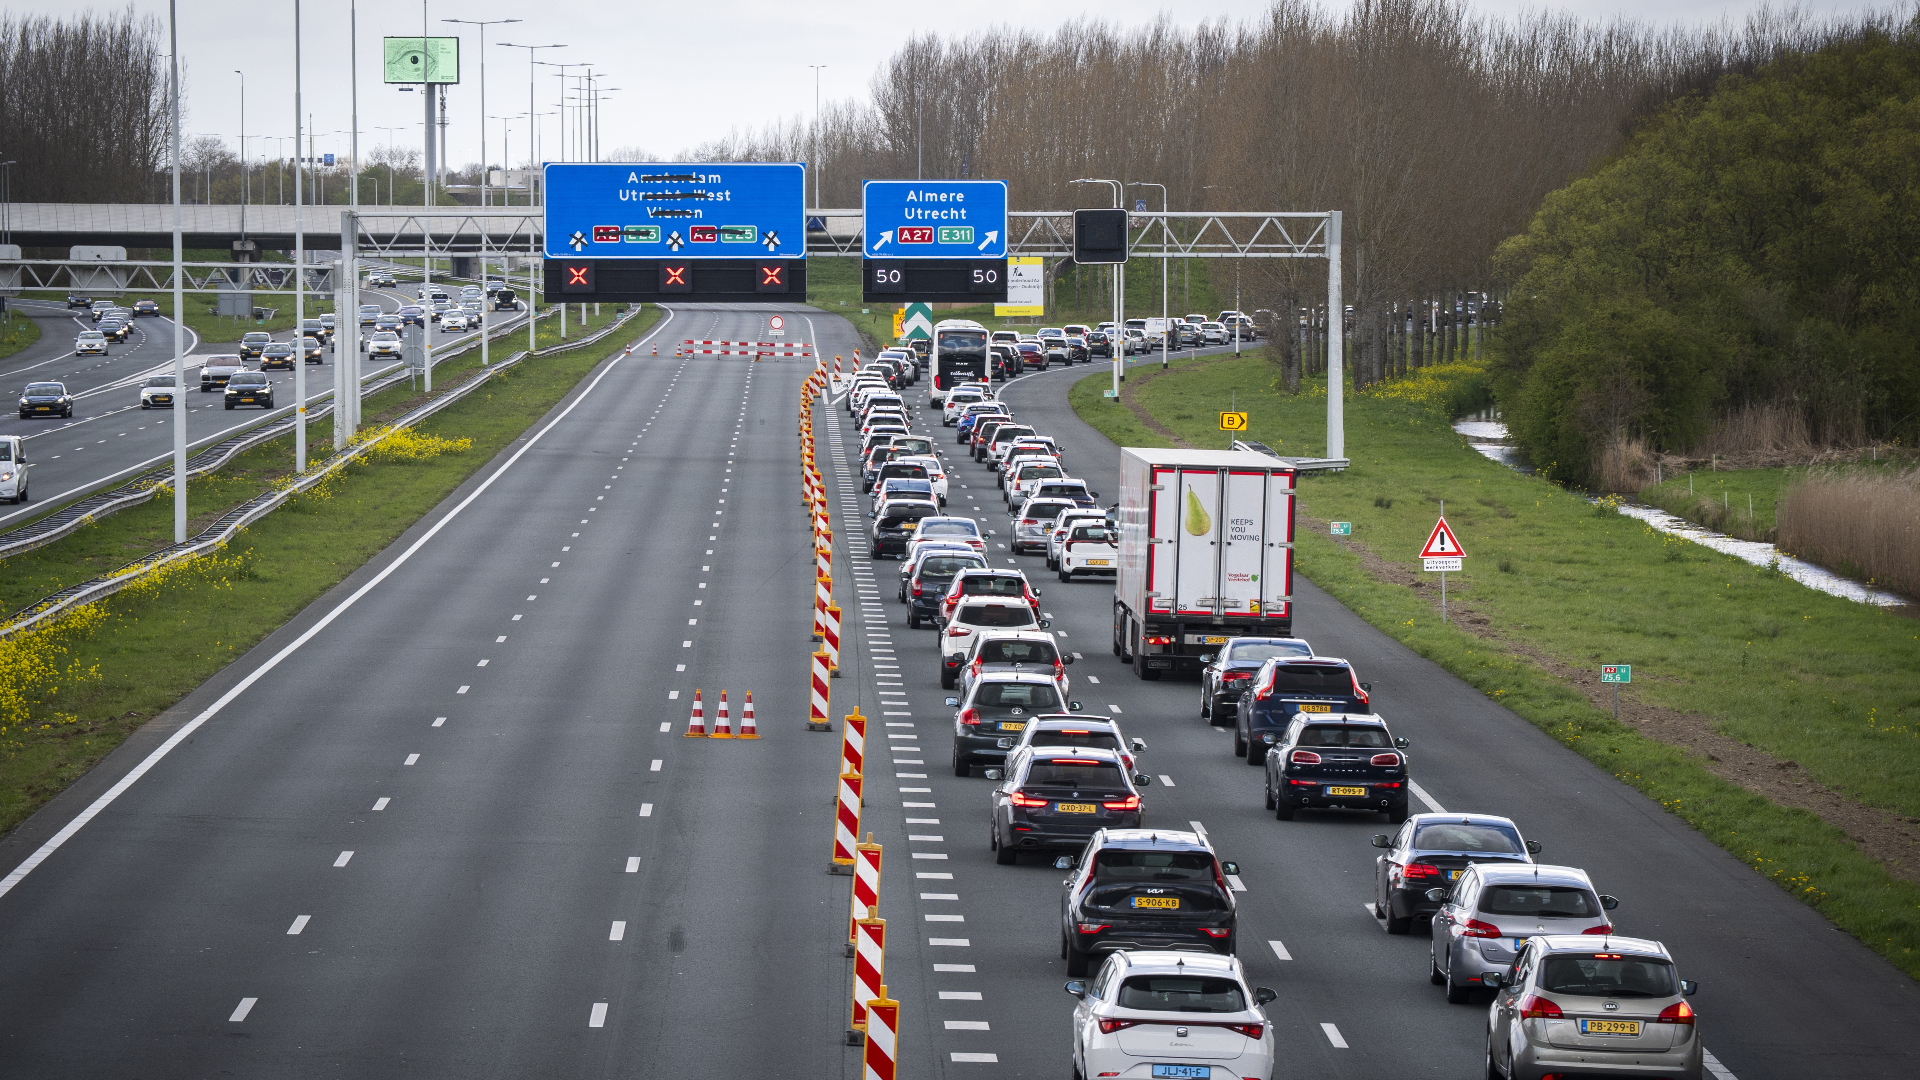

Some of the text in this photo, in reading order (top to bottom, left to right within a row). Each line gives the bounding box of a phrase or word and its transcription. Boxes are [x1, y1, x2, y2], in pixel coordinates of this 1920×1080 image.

[628, 172, 721, 184] Amsdam
[906, 190, 964, 202] Almere
[904, 208, 966, 220] Utrecht
[876, 270, 901, 283] 50
[973, 270, 997, 283] 50
[1228, 417, 1234, 425] B
[1138, 899, 1177, 907] S-906-KB
[1591, 1022, 1635, 1032] PB-299-B
[1162, 1067, 1202, 1076] JLJ-41-F
